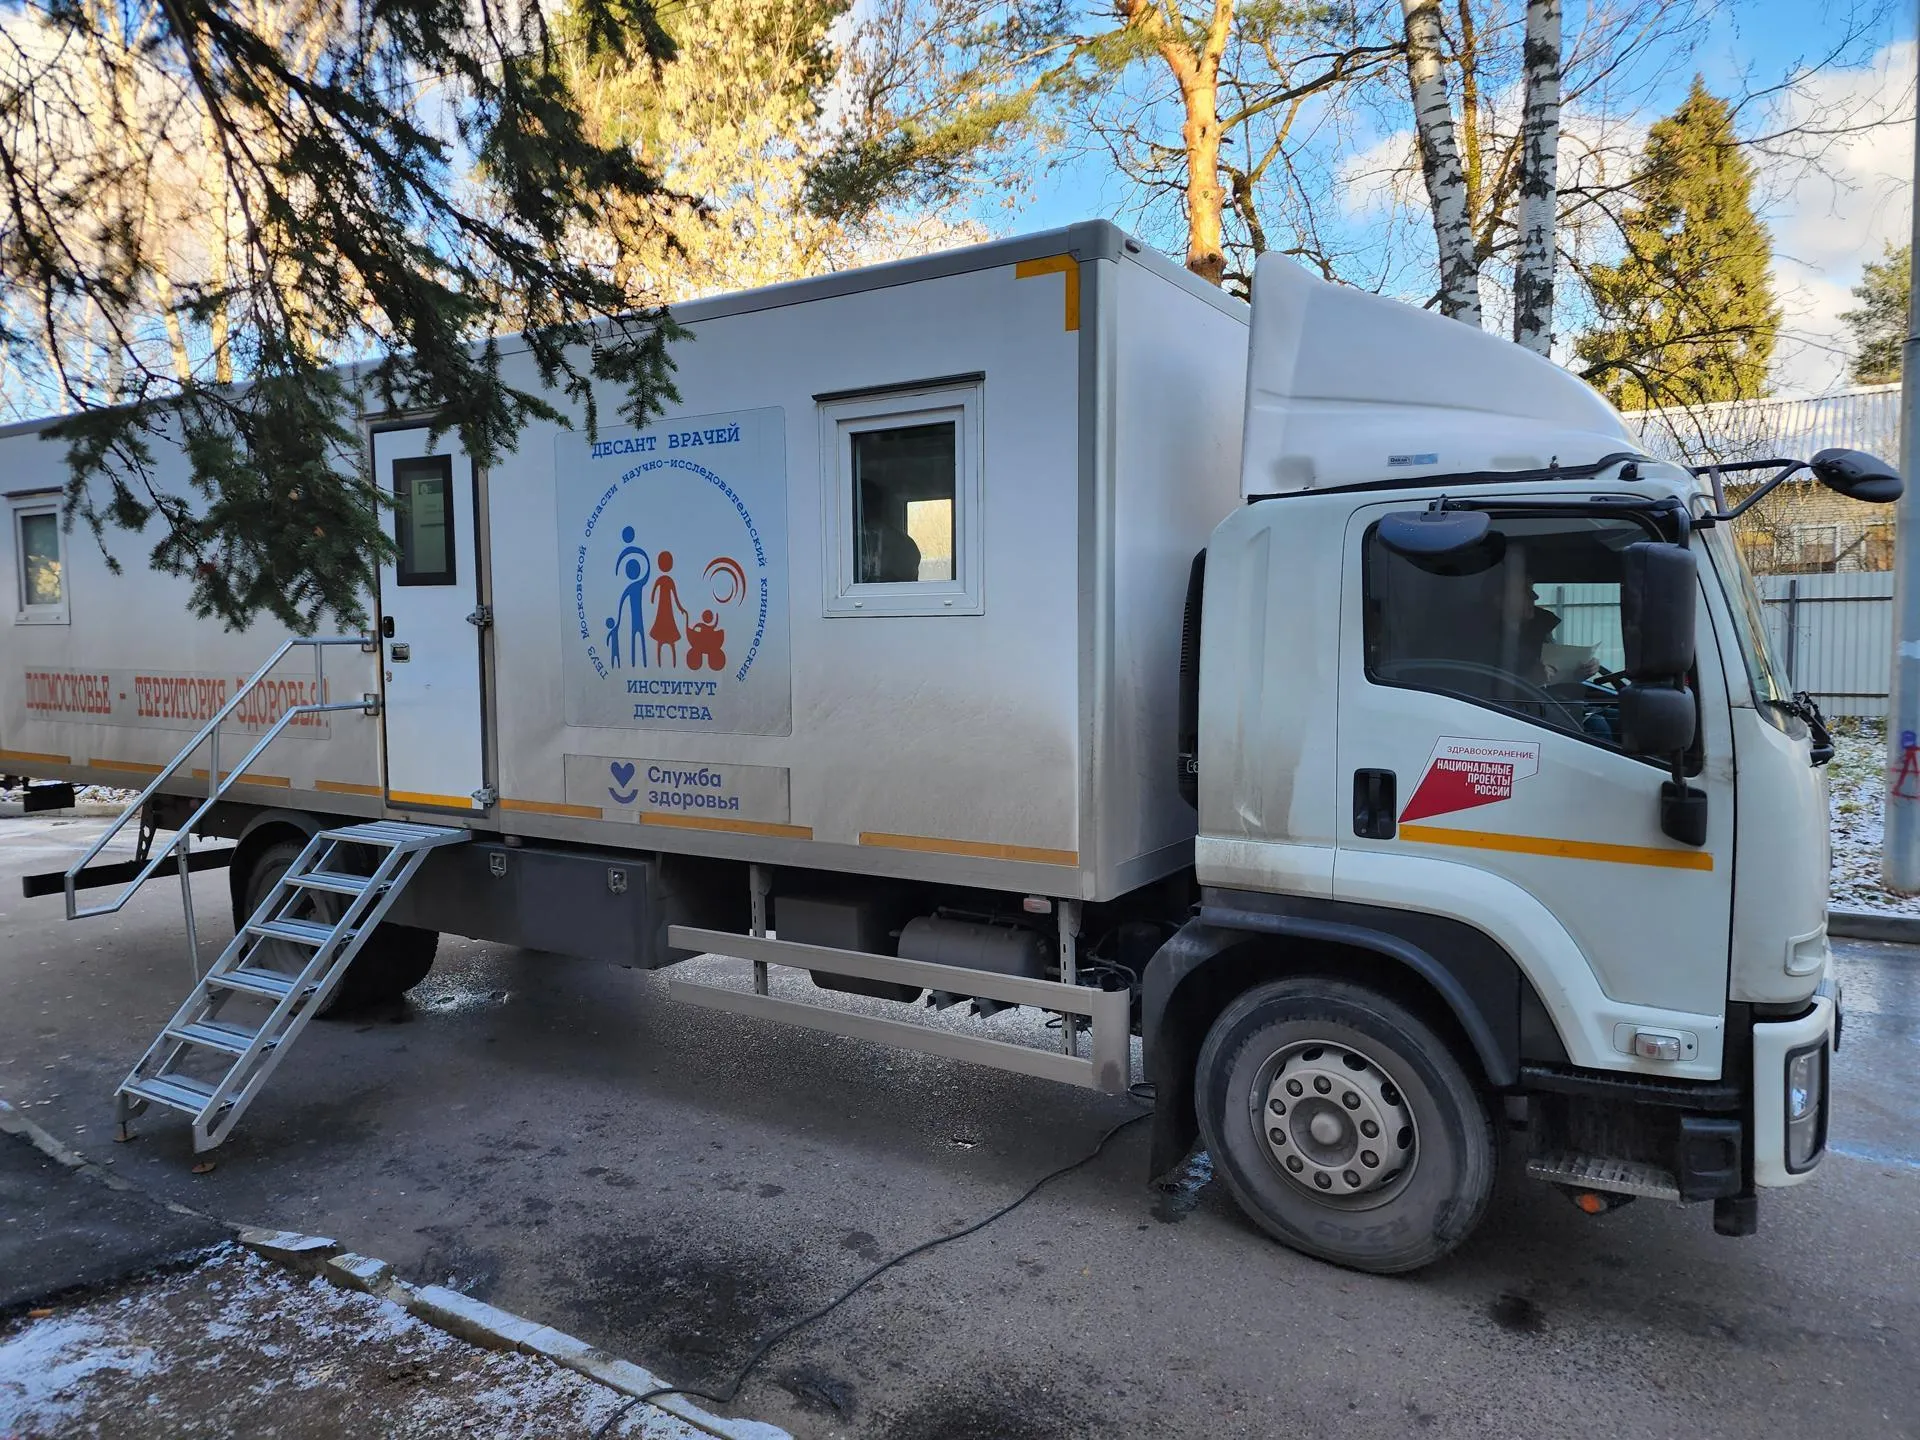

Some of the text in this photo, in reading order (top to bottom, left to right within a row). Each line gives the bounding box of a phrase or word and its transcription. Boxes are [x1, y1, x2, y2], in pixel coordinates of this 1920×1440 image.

[592, 422, 741, 459] ДЕСАНТ ВРАЧЕЙ
[584, 483, 618, 538] области
[621, 458, 768, 568] научно-исследовательский
[736, 578, 769, 682] клинический
[24, 671, 111, 715] ПОДМОСКОВЬЕ
[135, 676, 228, 721] ТЕРРИТОРИЯ
[627, 680, 717, 696] ИНСТИТУТ
[633, 704, 713, 721] ДЕТСТВА
[1447, 745, 1535, 760] ЗДРАВООХРАНЕНИЕ
[1437, 759, 1513, 776] НАЦИОНАЛЬНЫЕ
[647, 765, 722, 788] Служба
[1467, 774, 1511, 786] ПРОЕКТЫ
[1474, 784, 1511, 797] РОССИИ
[648, 789, 740, 811] здоровья
